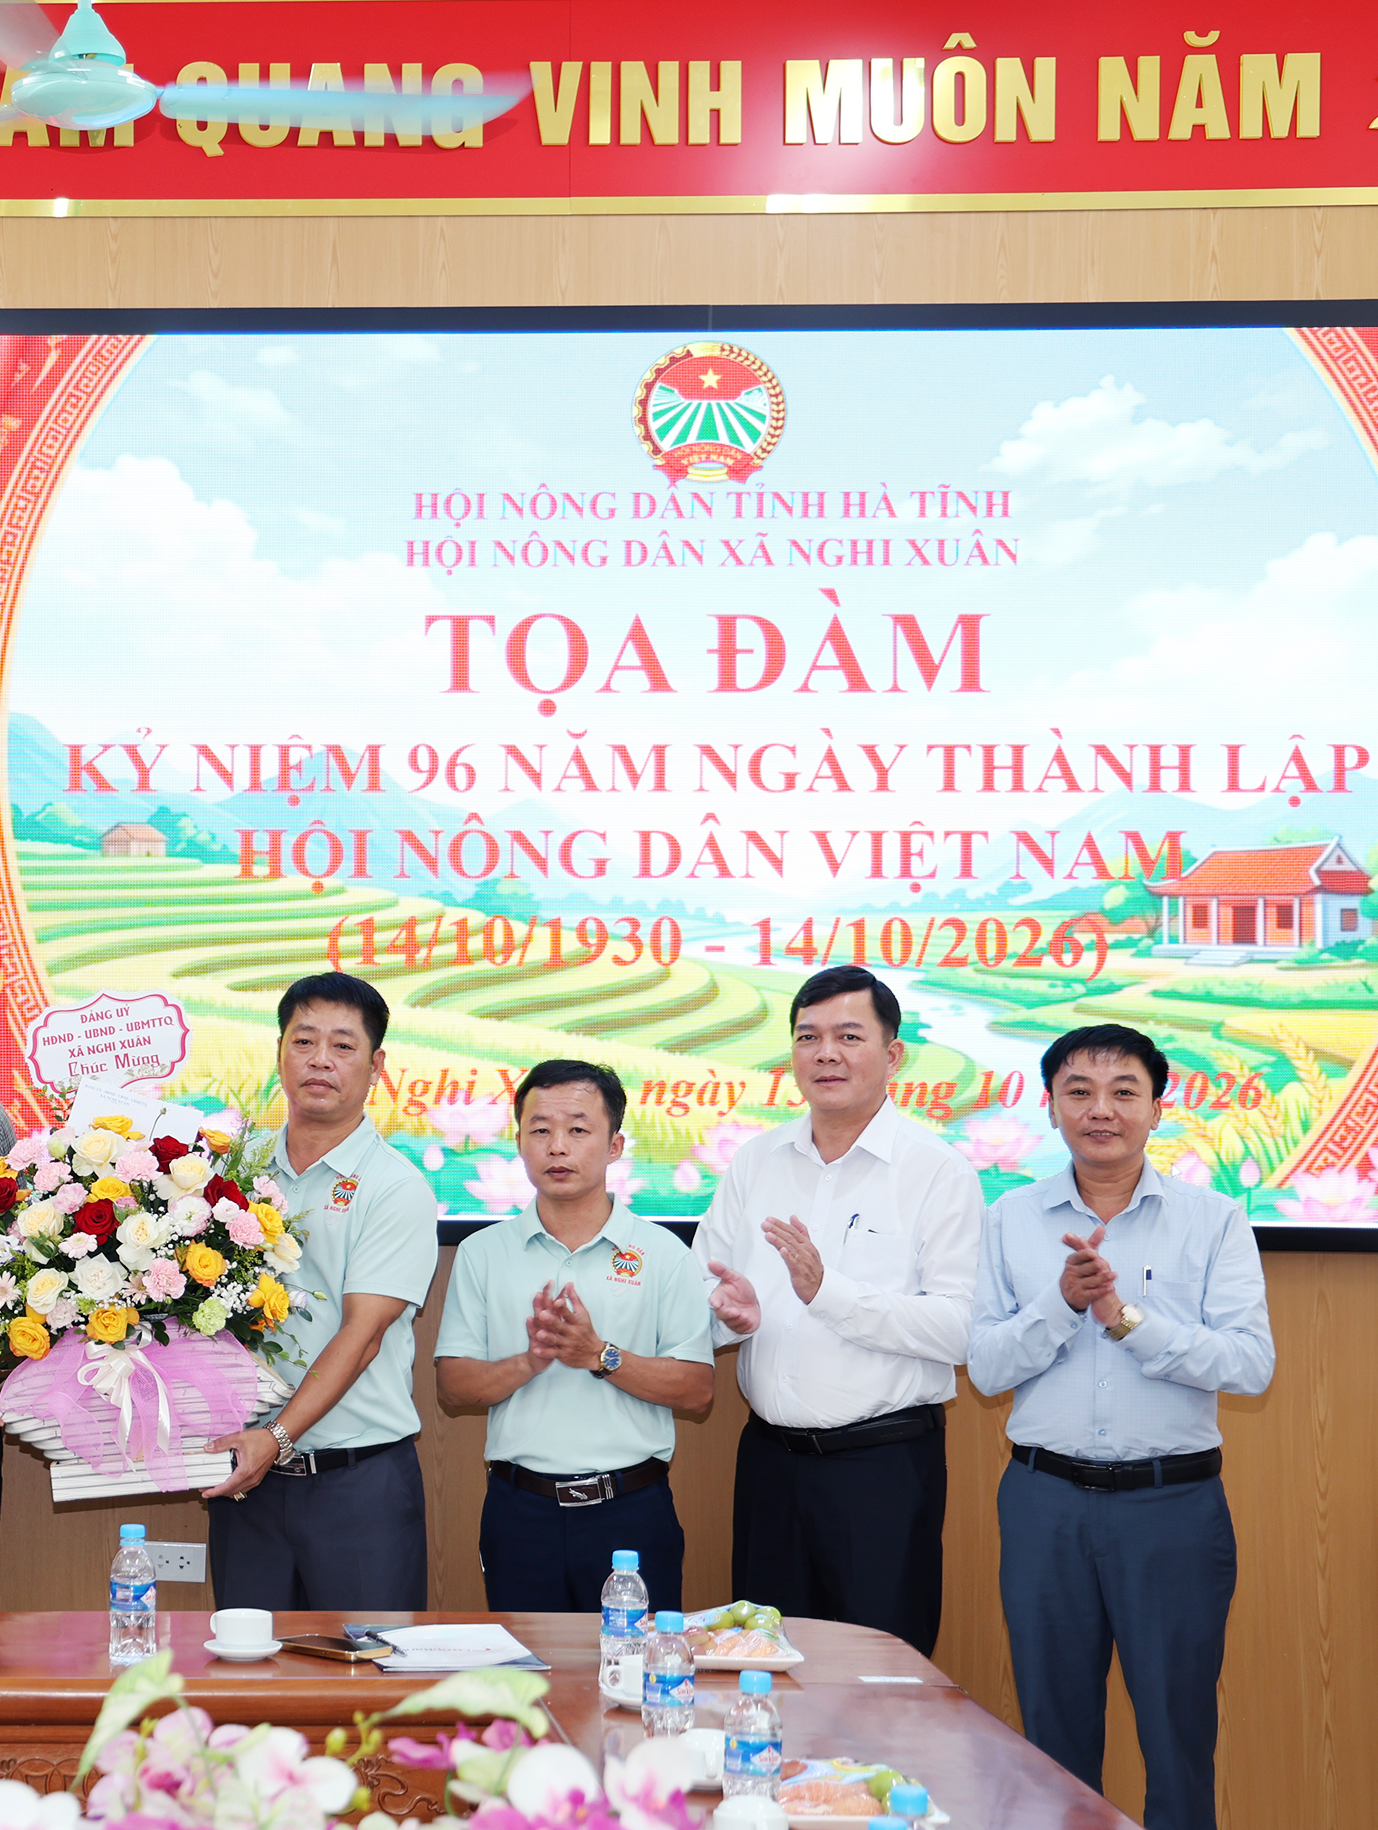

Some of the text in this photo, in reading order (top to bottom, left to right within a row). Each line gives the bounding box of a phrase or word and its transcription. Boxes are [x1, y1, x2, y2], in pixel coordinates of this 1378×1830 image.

[529, 60, 743, 146] VINH
[785, 32, 1056, 146] MUÔN
[1097, 30, 1321, 143] NĂM
[413, 482, 1013, 529] HỘI NÔNG DÂN TỈNH HÀ TĨNH
[405, 528, 1020, 576] HỘI NÔNG DÂN XÃ NGHI XUÂN
[424, 587, 991, 717] TỌA ĐÀM
[63, 726, 1371, 807] KỶ NIỆM 96 NĂM NGÀY THÀNH LẬP
[233, 812, 1188, 894] HỘI NÔNG DÂN VIỆT NAM
[327, 914, 1110, 982] (14/10/1930 - 14/10/2026)
[42, 1032, 75, 1046] HĐND
[85, 1025, 116, 1039] UBND
[126, 1016, 175, 1032] UBMTTQ
[80, 1009, 113, 1024] ĐẢNG
[68, 1035, 152, 1058] XÃ NGHI XUÂN
[68, 1053, 160, 1077] Chúc Mừng
[366, 1068, 478, 1117] Nghi
[639, 1068, 746, 1117] ngày
[970, 1070, 1025, 1109] 10
[1160, 1071, 1264, 1110] 2026
